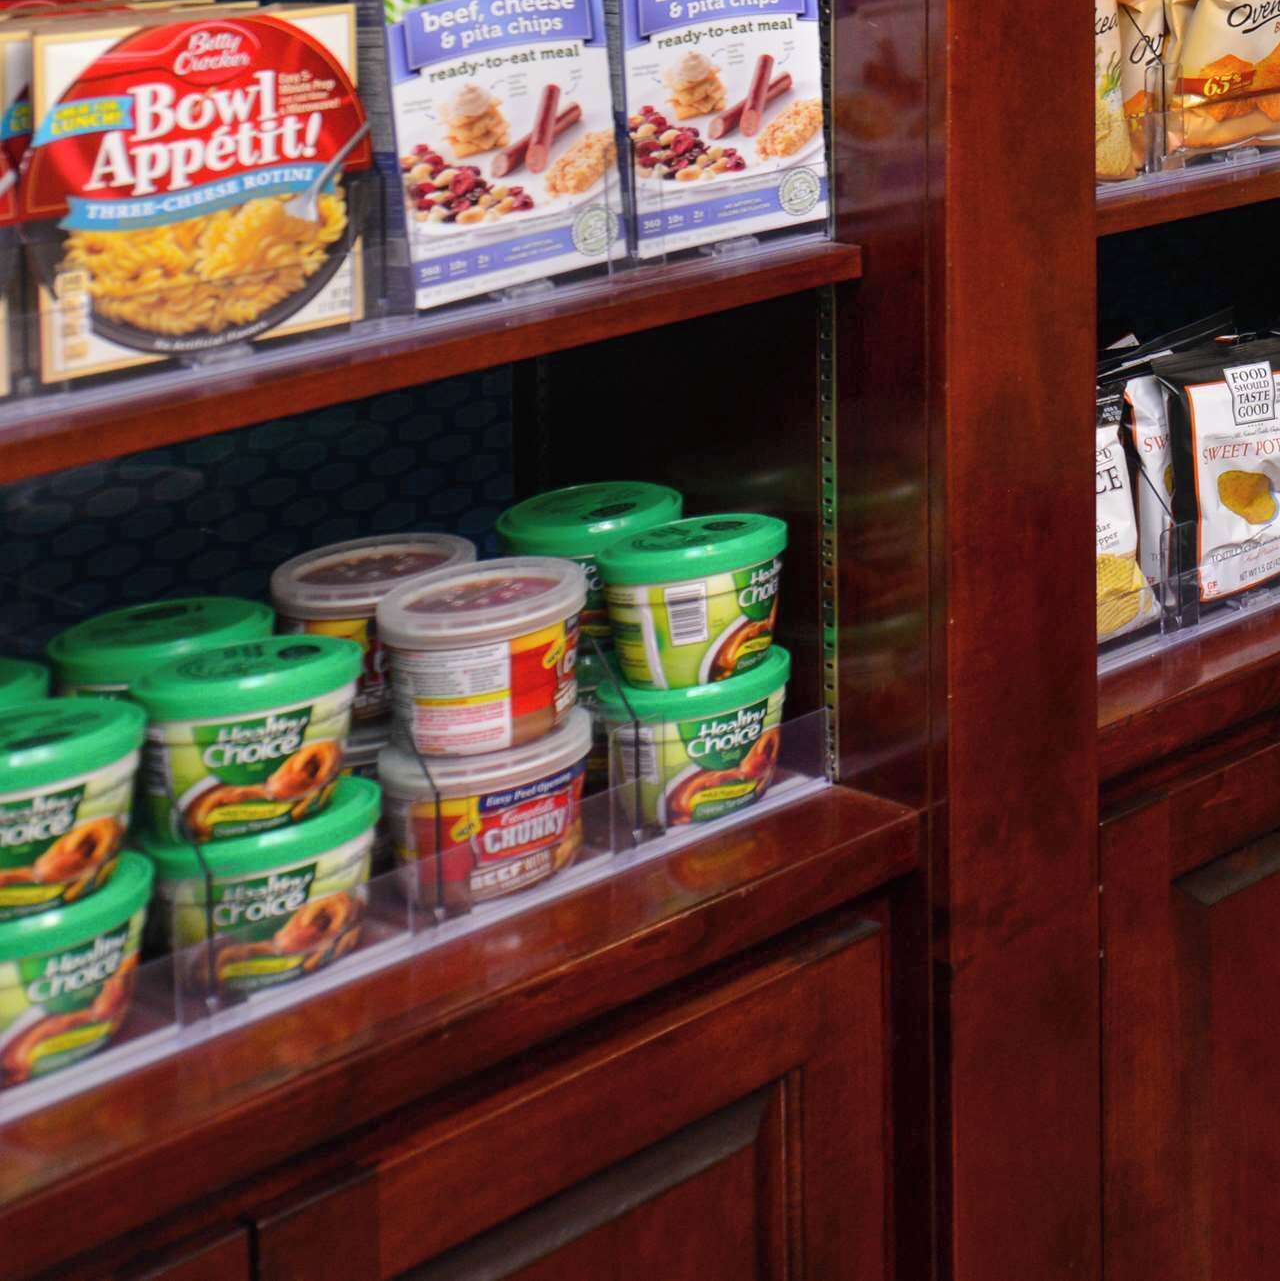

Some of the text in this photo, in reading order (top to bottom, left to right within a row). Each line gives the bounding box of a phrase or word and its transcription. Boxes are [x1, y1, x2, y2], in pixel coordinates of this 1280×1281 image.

[669, 0, 686, 18] &
[188, 30, 242, 55] Betty
[440, 14, 565, 50] & pita chips
[657, 17, 794, 50] ready-to-eat meal
[173, 47, 252, 75] Crocker
[429, 43, 580, 84] ready-to-eat meal
[126, 69, 278, 143] Bowl
[82, 111, 324, 197] Appétit!
[86, 166, 315, 220] THREE-CHEESE ROTINI
[1231, 366, 1268, 385] FOOD
[1233, 380, 1271, 394] SHOULD
[1236, 390, 1271, 406] TASTE
[1238, 402, 1269, 420] GOOD
[1202, 442, 1254, 466] SWEET
[698, 708, 768, 739] Healthy
[202, 737, 302, 768] Choice
[686, 727, 763, 759] Choice
[514, 785, 536, 800] Peel
[483, 807, 566, 855] CHUNKY
[27, 954, 122, 1001] Choice
